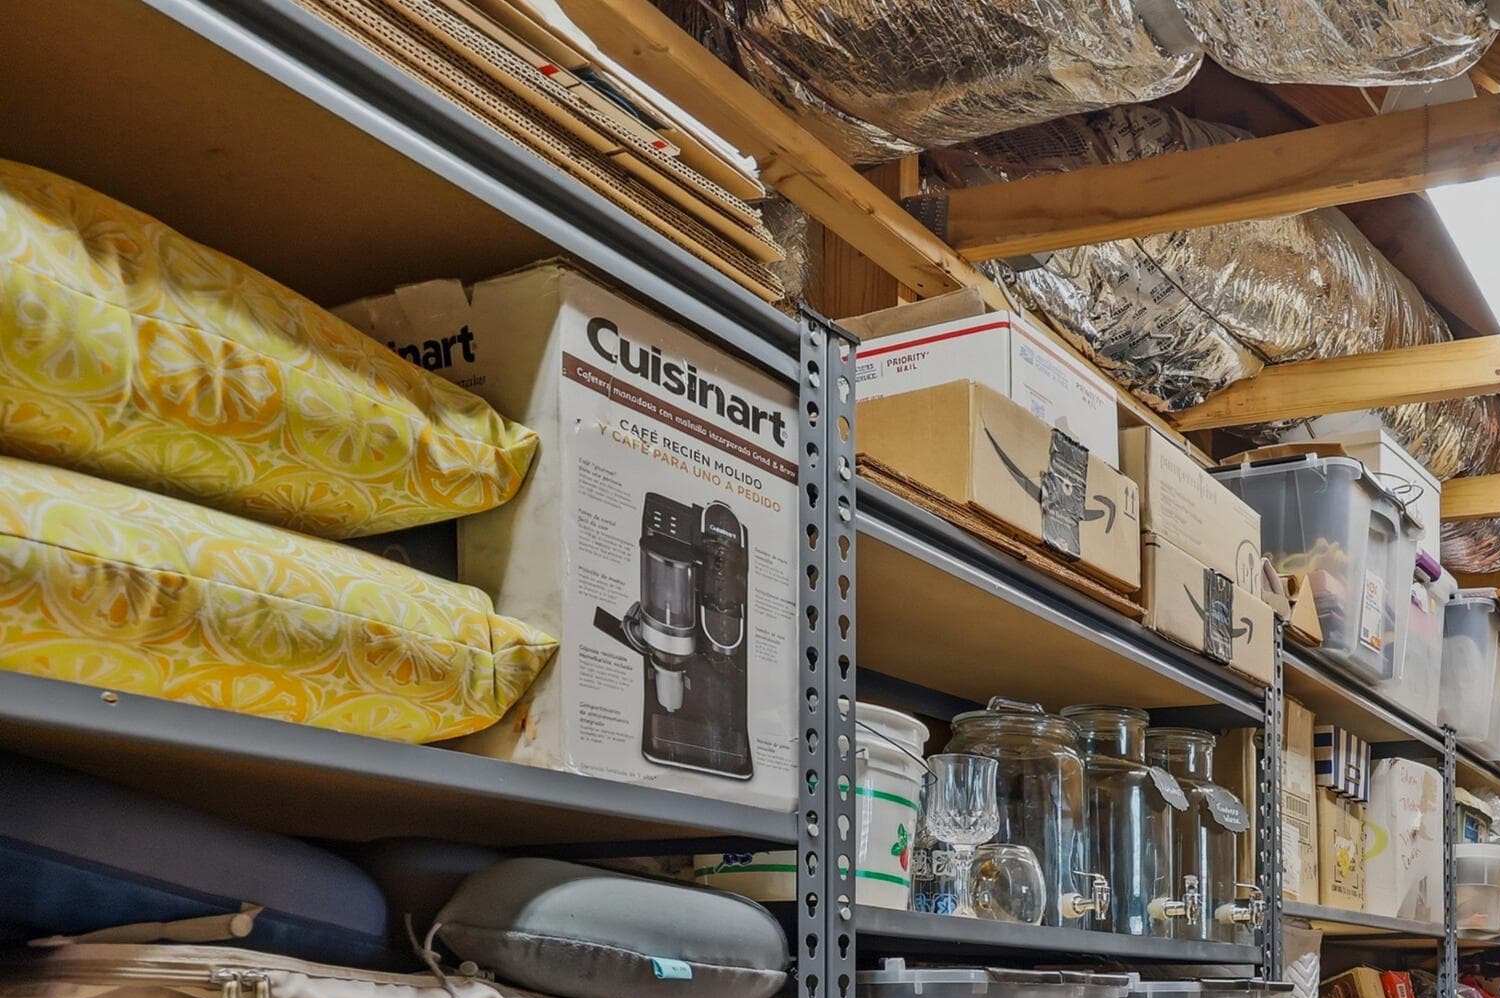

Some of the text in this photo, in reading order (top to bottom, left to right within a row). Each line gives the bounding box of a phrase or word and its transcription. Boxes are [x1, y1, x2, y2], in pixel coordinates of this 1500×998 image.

[586, 317, 786, 448] Cuisinart
[887, 352, 927, 367] PRIORITY
[897, 365, 918, 373] MAIL
[599, 424, 782, 513] Y CAFÉ PARA UNO A PEDIDO
[619, 419, 762, 491] CAFÉ RECIÉN MOLIDO
